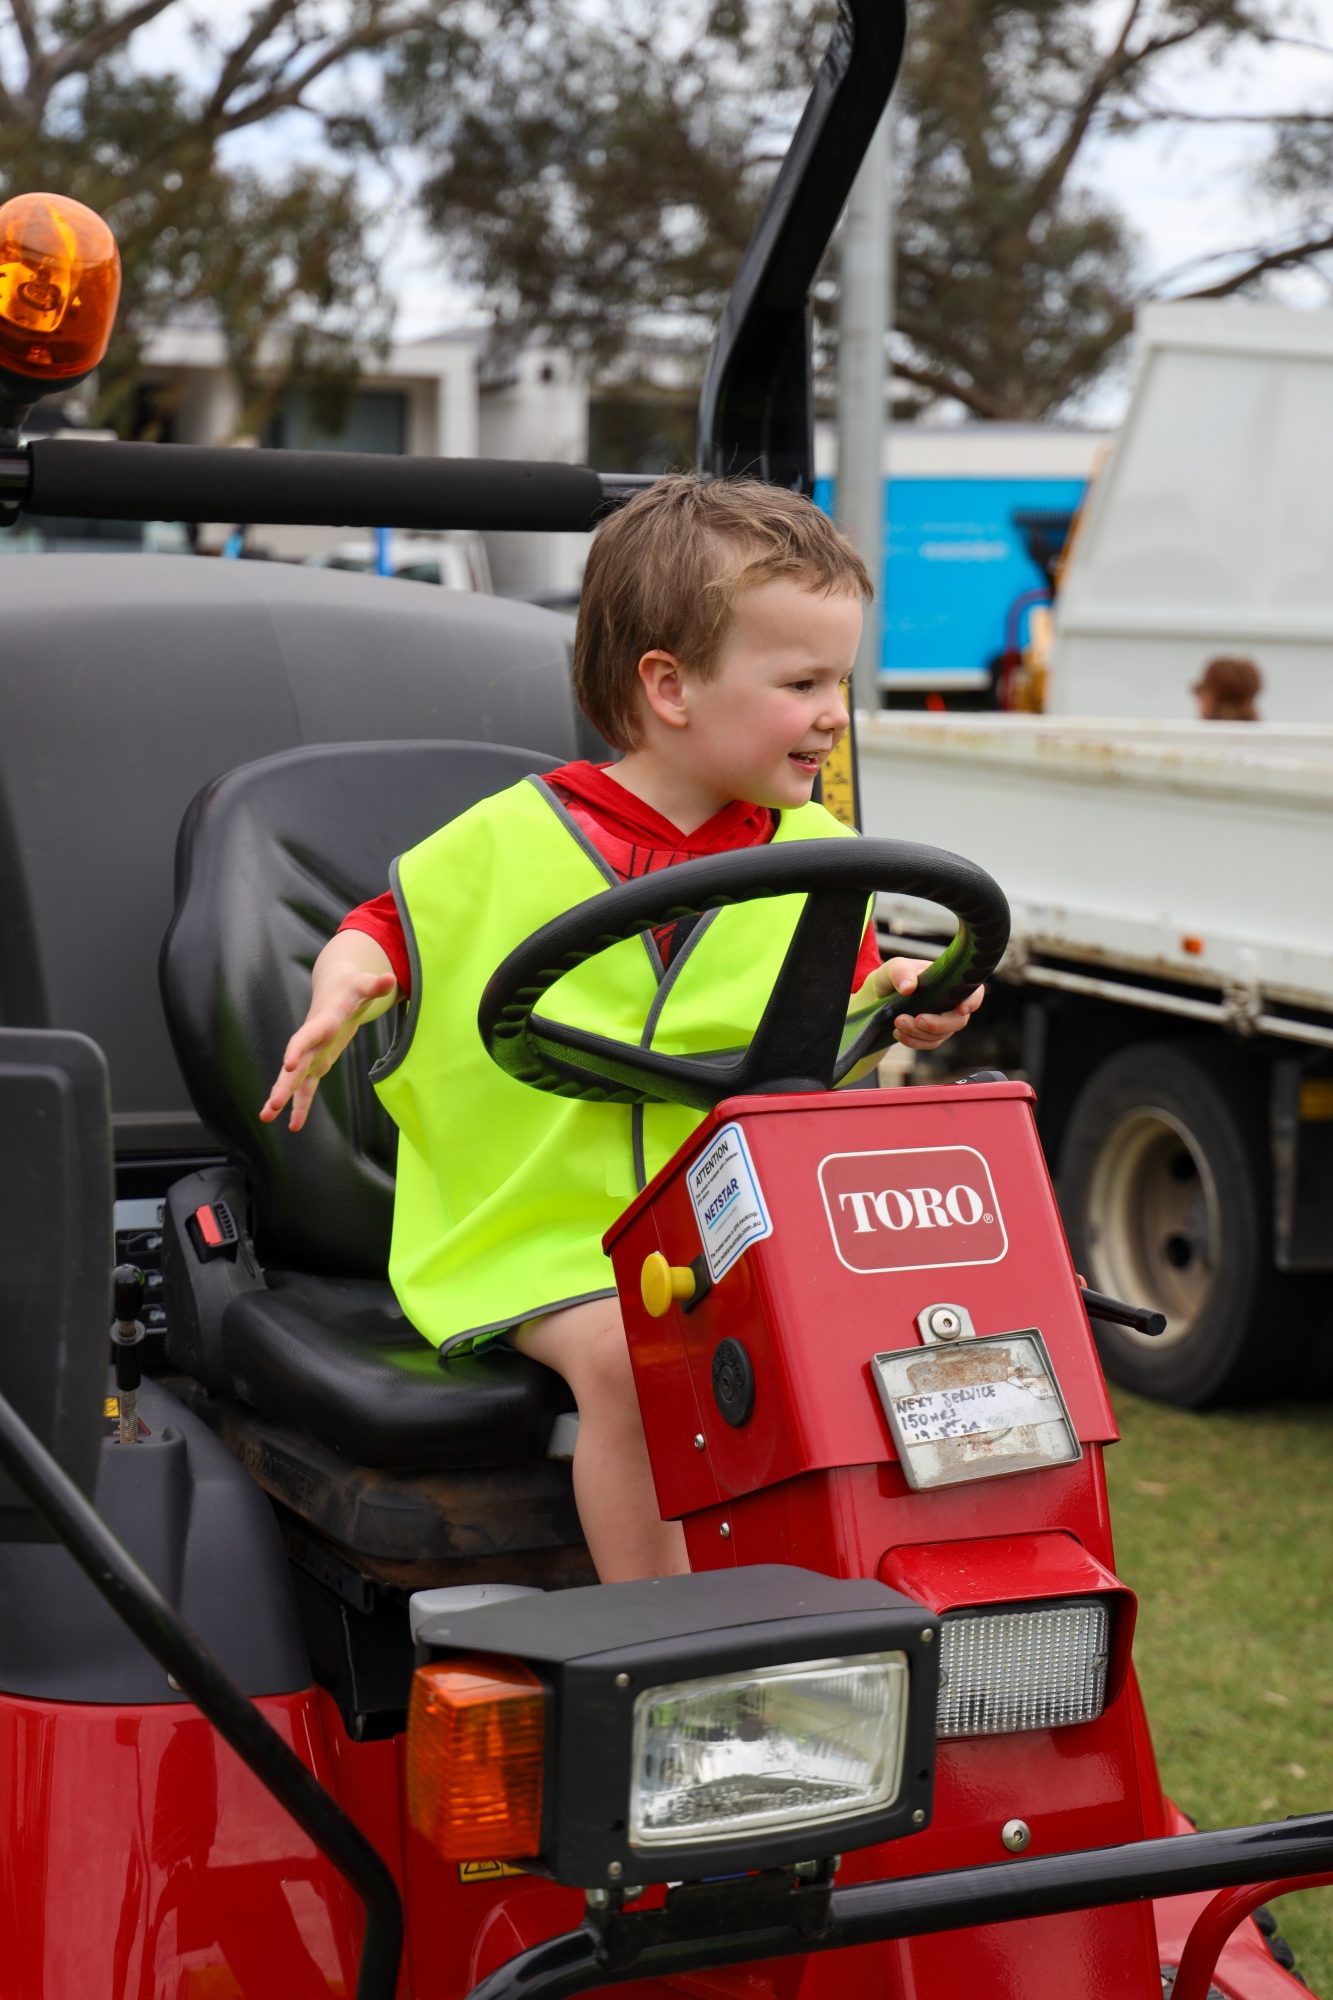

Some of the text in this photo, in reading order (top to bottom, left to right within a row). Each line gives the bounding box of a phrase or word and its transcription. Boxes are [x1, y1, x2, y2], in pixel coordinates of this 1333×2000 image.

[695, 1140, 729, 1187] ATTENTION
[704, 1177, 740, 1224] NETSTAR
[896, 1396, 933, 1414] NEXT
